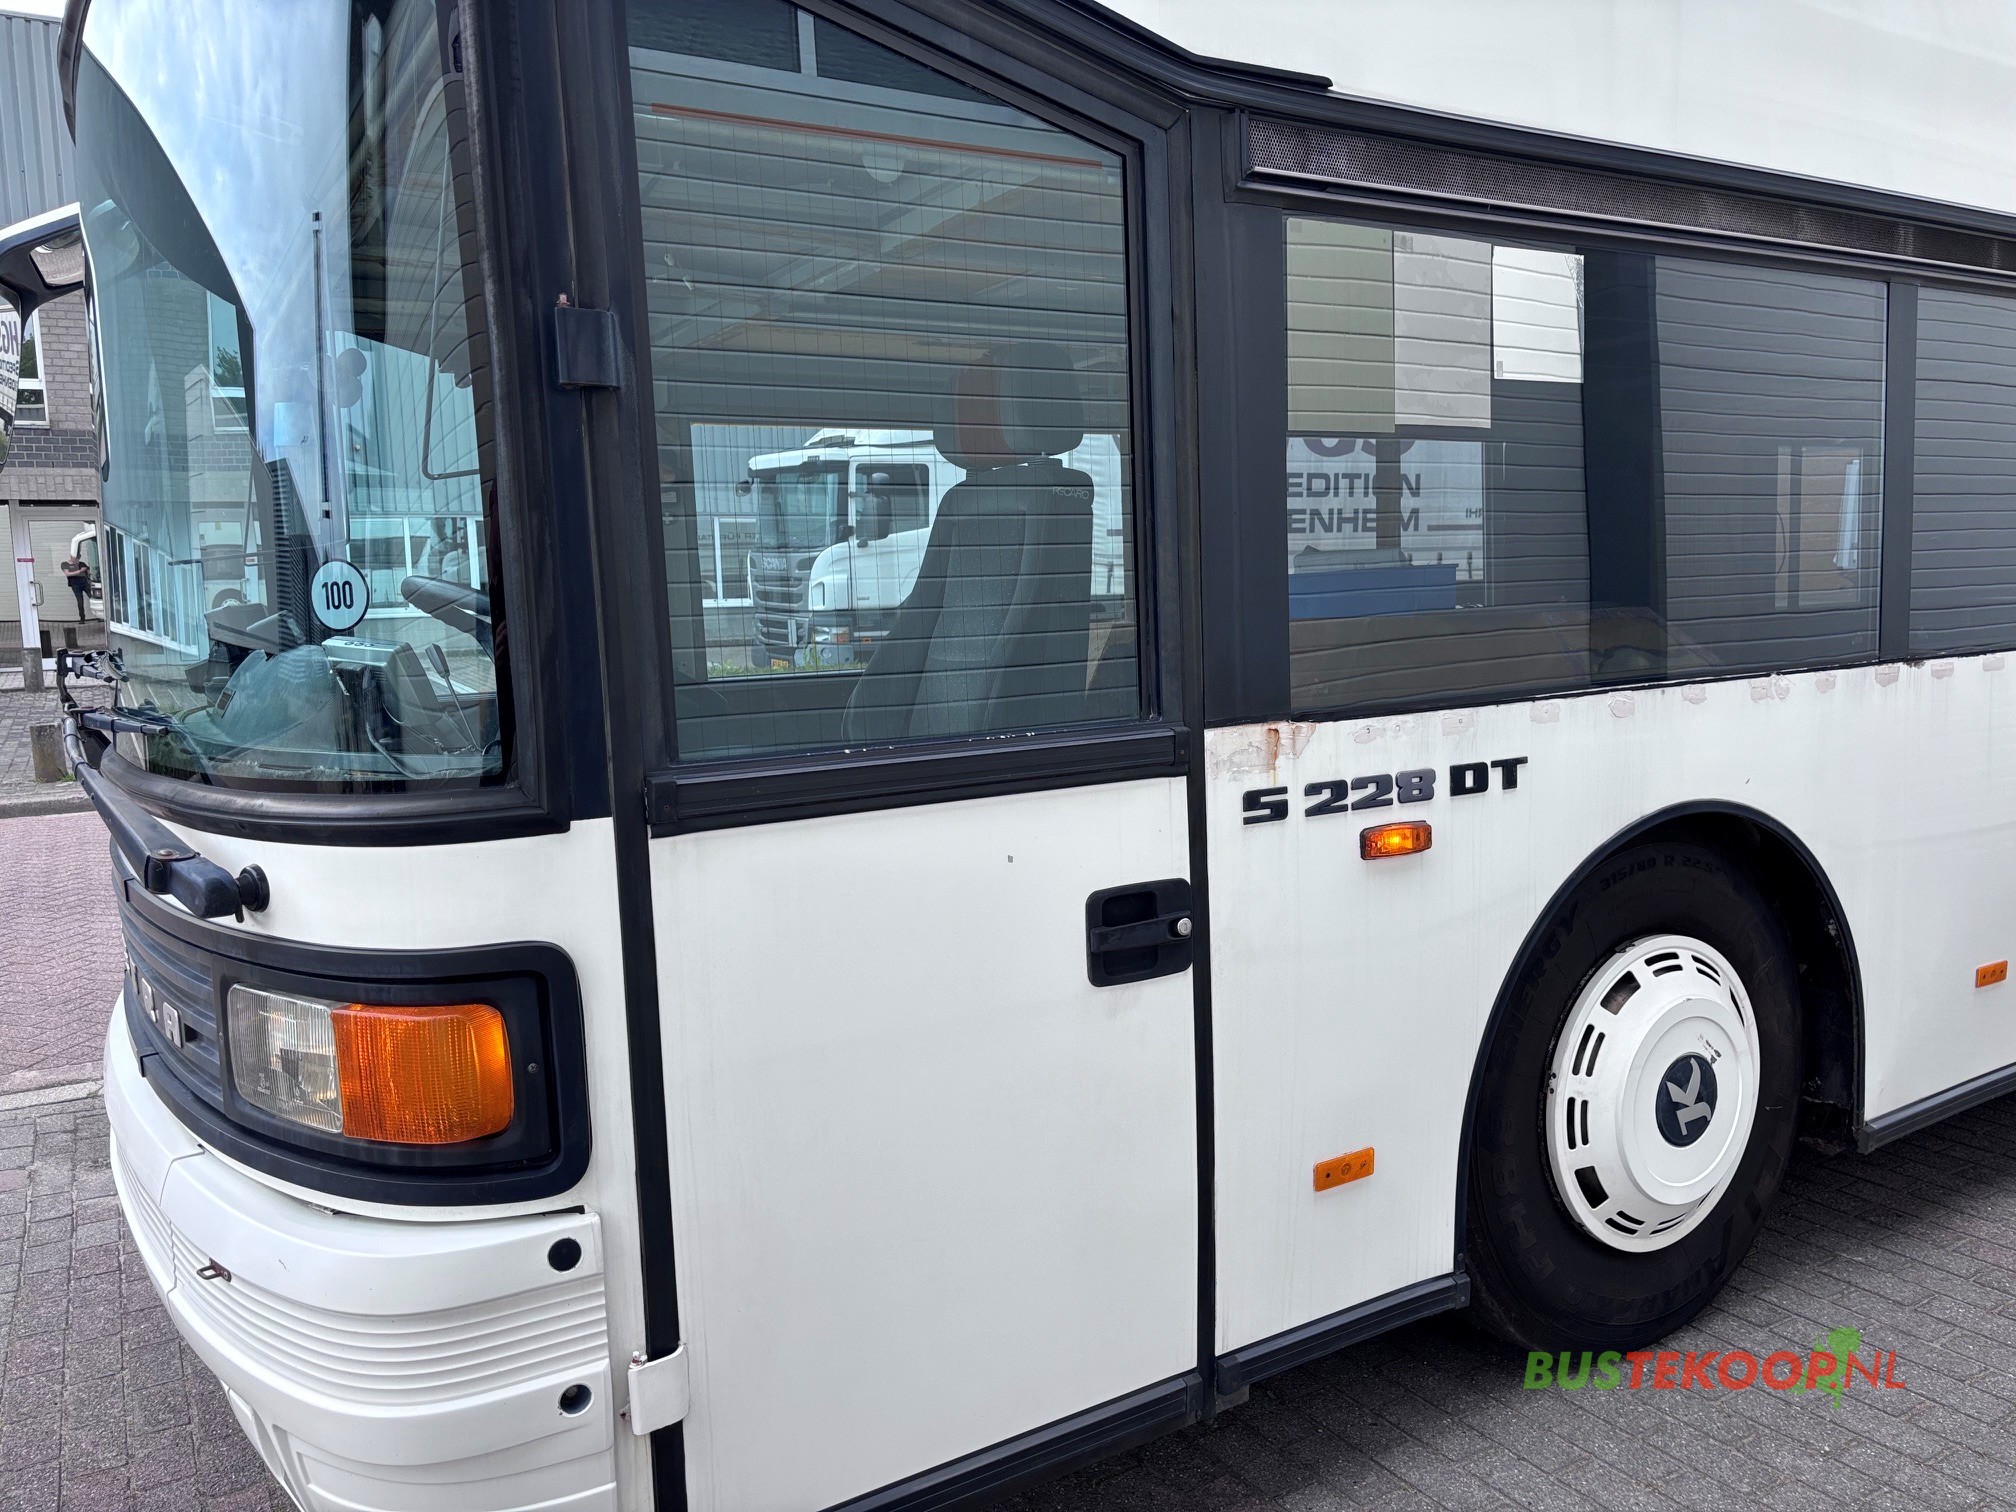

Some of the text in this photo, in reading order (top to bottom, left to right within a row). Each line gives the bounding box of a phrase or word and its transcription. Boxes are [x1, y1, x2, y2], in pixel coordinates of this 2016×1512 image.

[1287, 472, 1421, 498] EDITIN
[1287, 508, 1420, 534] ENHEM
[321, 580, 354, 611] 100
[1242, 756, 1528, 826] S 228 DT
